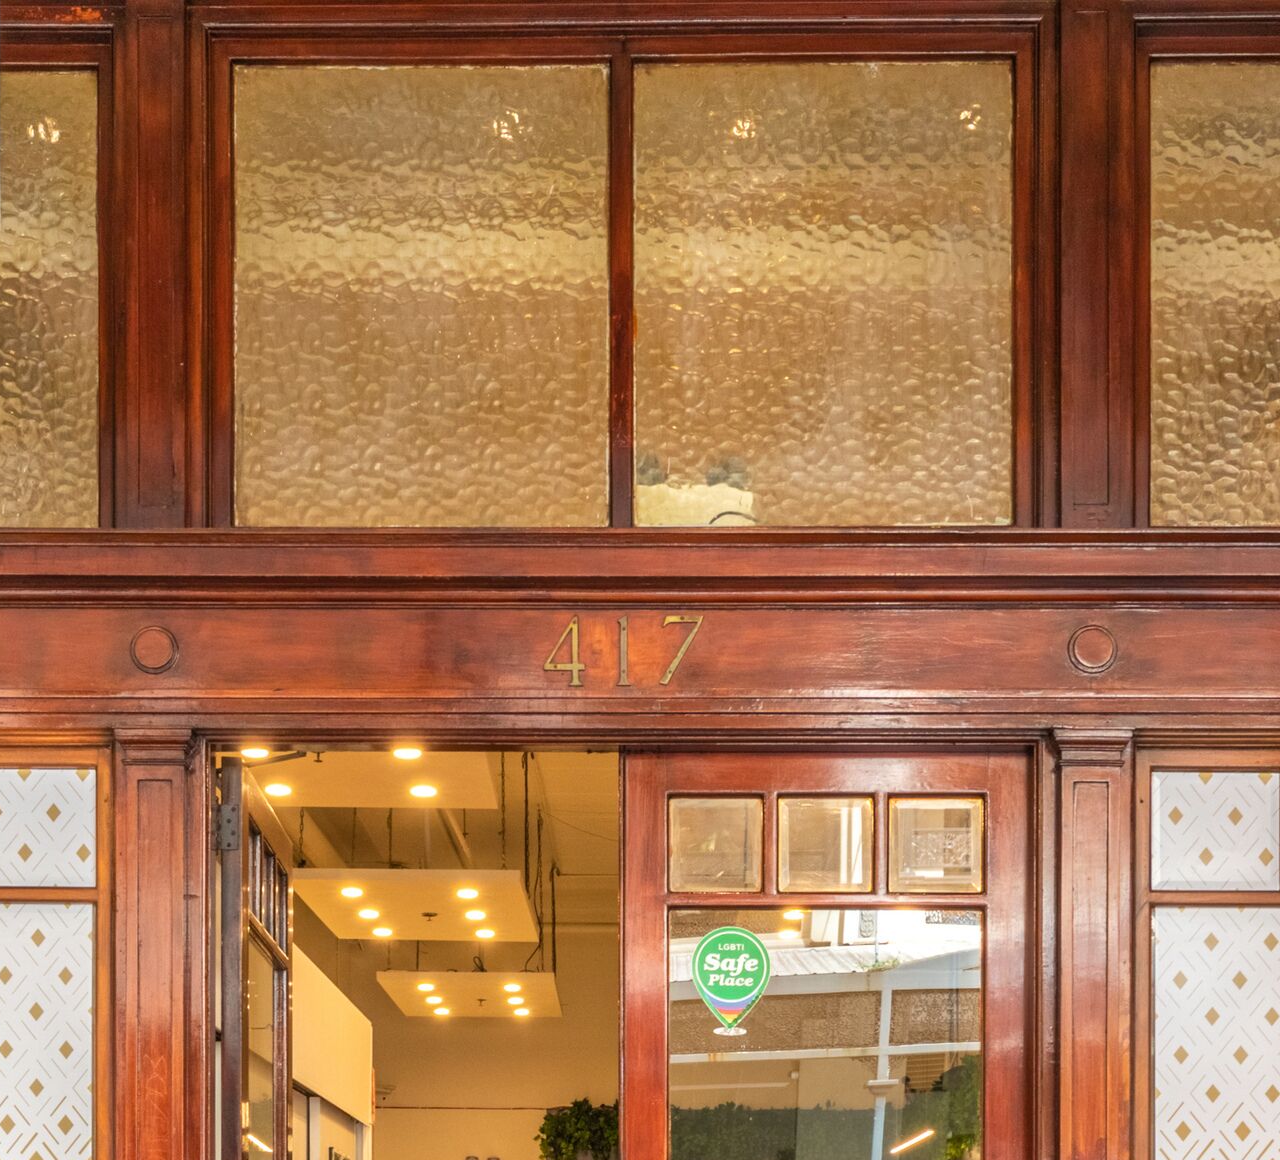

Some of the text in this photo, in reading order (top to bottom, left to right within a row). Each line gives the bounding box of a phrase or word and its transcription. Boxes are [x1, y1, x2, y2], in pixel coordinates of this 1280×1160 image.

[543, 615, 705, 687] 417
[718, 943, 745, 951] LGBTI
[703, 953, 759, 976] Safe
[707, 974, 754, 986] Place
